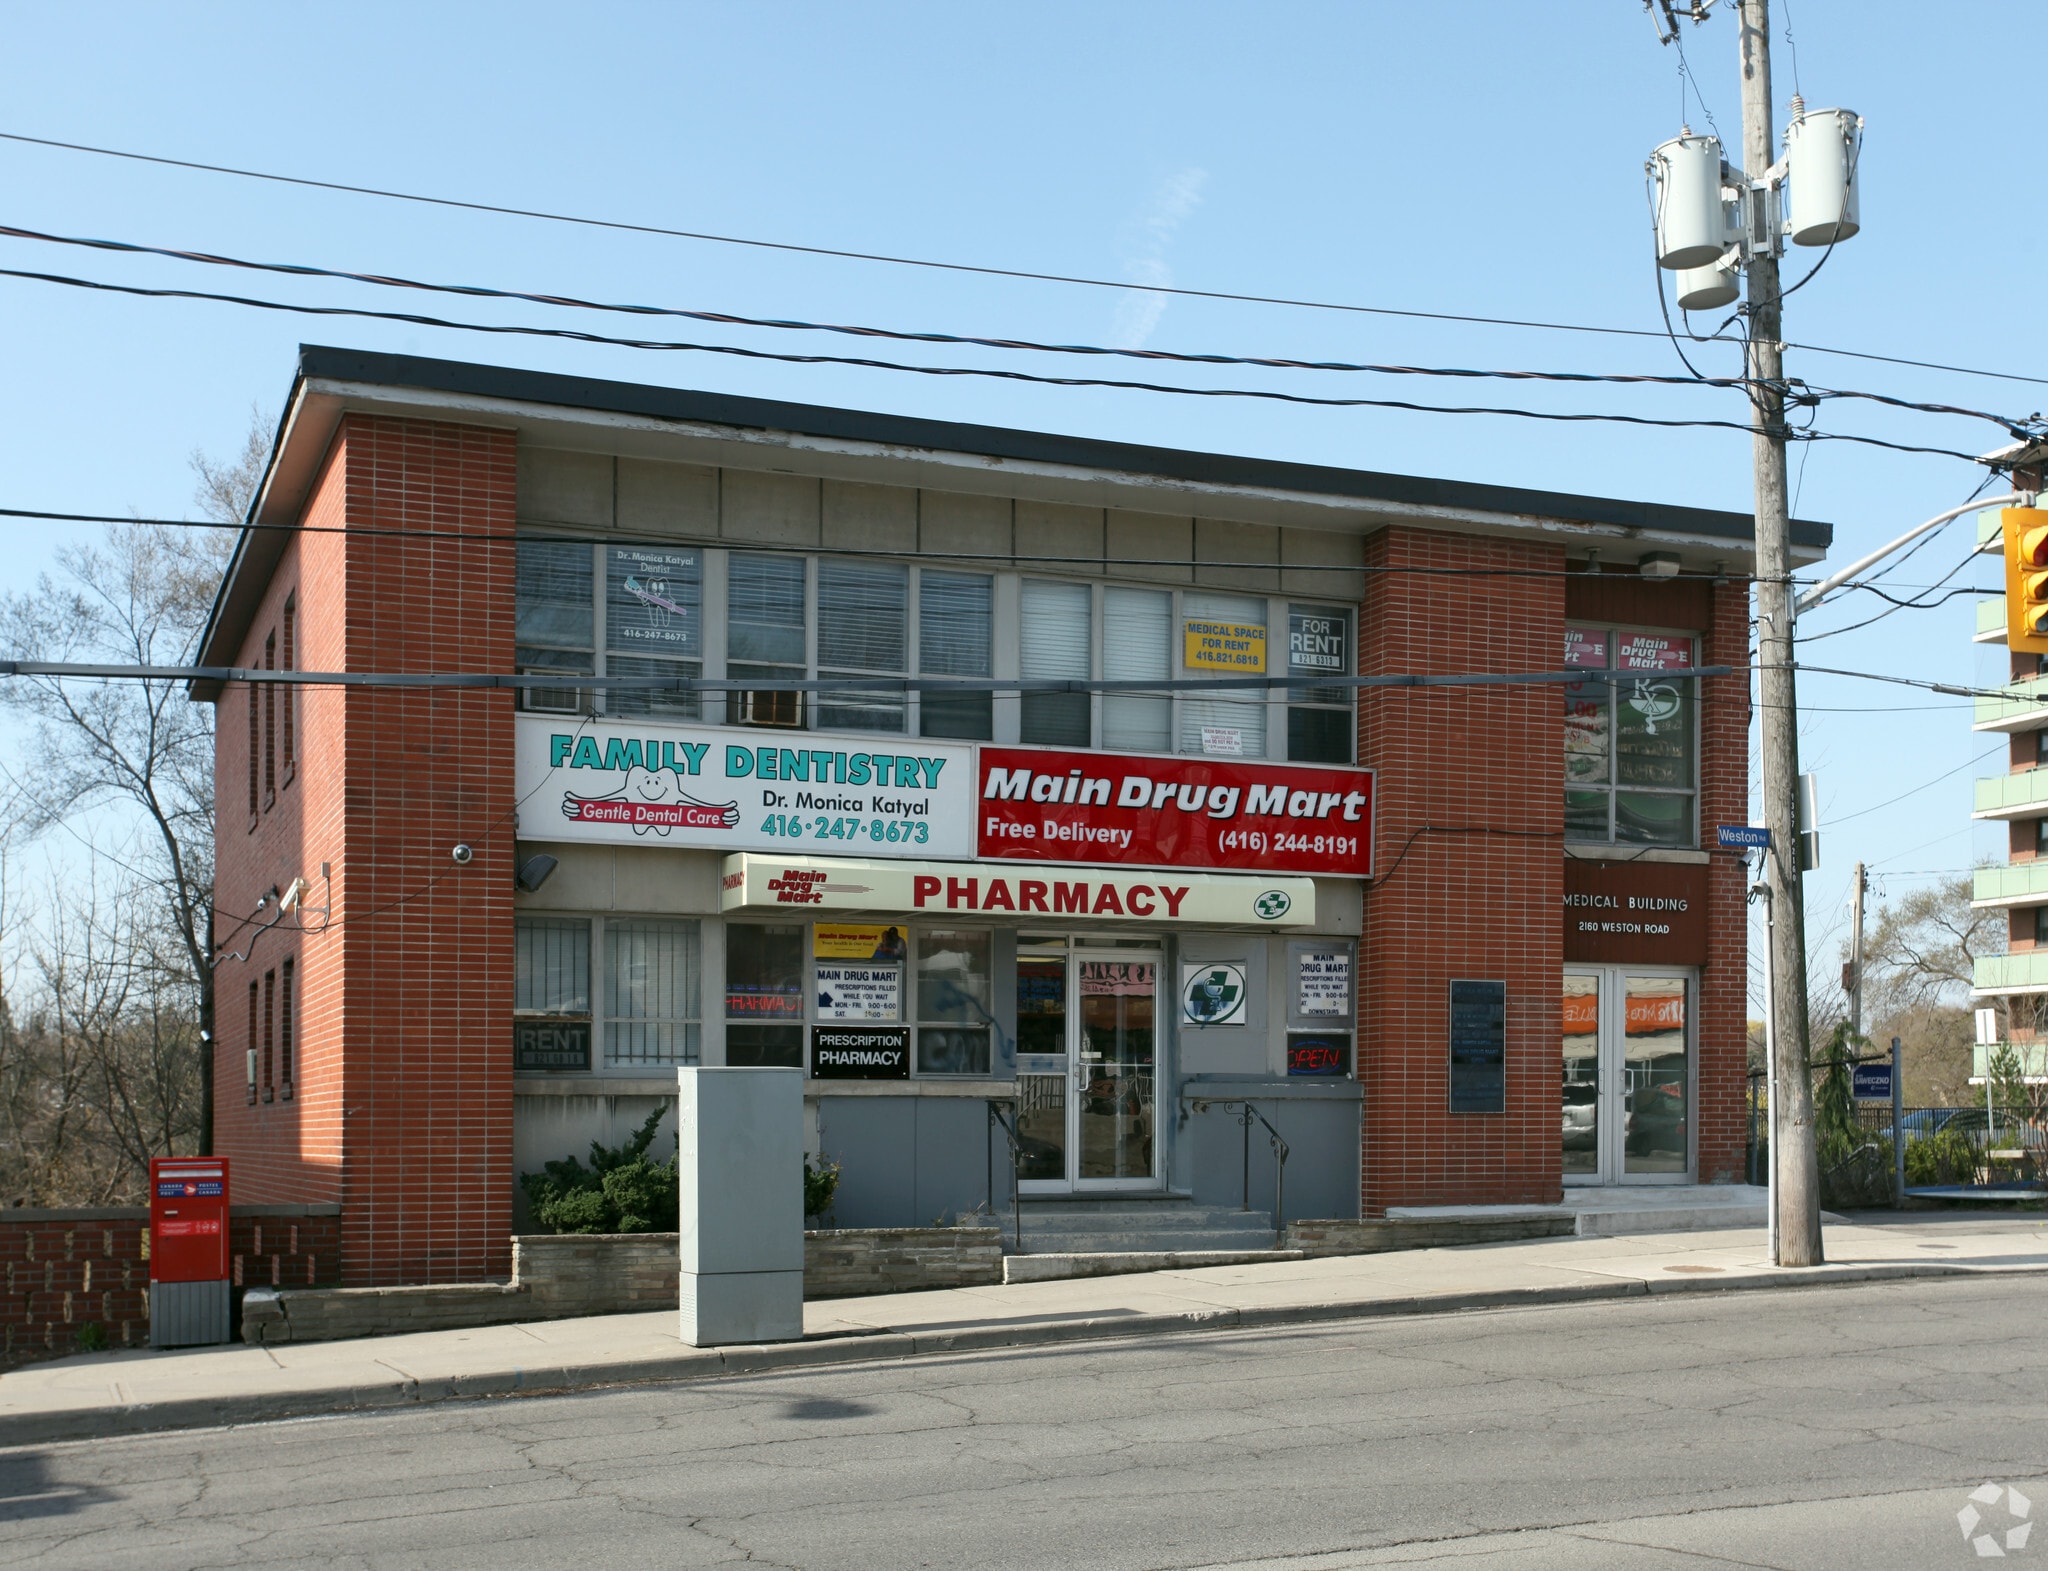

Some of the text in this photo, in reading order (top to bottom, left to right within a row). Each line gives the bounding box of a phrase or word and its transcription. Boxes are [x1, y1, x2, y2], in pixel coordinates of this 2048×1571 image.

[617, 551, 694, 566] Dr. Monica Katyal
[640, 563, 670, 573] Dentist
[1188, 623, 1265, 639] MEDICAL SPACE
[1302, 619, 1330, 634] FOR
[624, 629, 687, 641] 416-247-8673
[1202, 638, 1250, 651] FOR RENT
[1290, 633, 1341, 655] RENT
[1632, 637, 1669, 650] Main
[1196, 651, 1259, 665] 416.821.6818
[1621, 645, 1657, 660] Drug
[1628, 657, 1665, 669] Mart
[551, 734, 947, 790] FAMILY DENTISTRY
[983, 767, 1367, 822] Main Drug Mart
[763, 790, 929, 818] Dr. Monica Katyal
[583, 804, 719, 825] Gentle Dental Care
[986, 817, 1133, 849] Free Delivery
[1719, 829, 1758, 843] Weston
[1218, 829, 1357, 855] (416) 244-8191
[783, 870, 828, 883] Main
[767, 879, 813, 894] Drug
[777, 891, 824, 904] Mart
[913, 875, 1190, 917] PHARMACY
[1562, 894, 1688, 912] MEDICAL BUILDING
[1579, 921, 1670, 934] 2160 WESTON ROAD
[818, 970, 897, 982] MAIN DRUG MART
[1325, 964, 1348, 973] MART
[878, 984, 896, 992] FILLED
[521, 1029, 587, 1050] RENT
[819, 1035, 902, 1047] PRESCRIPTION
[819, 1051, 902, 1066] PHARMACY
[1287, 1049, 1340, 1068] OPEN
